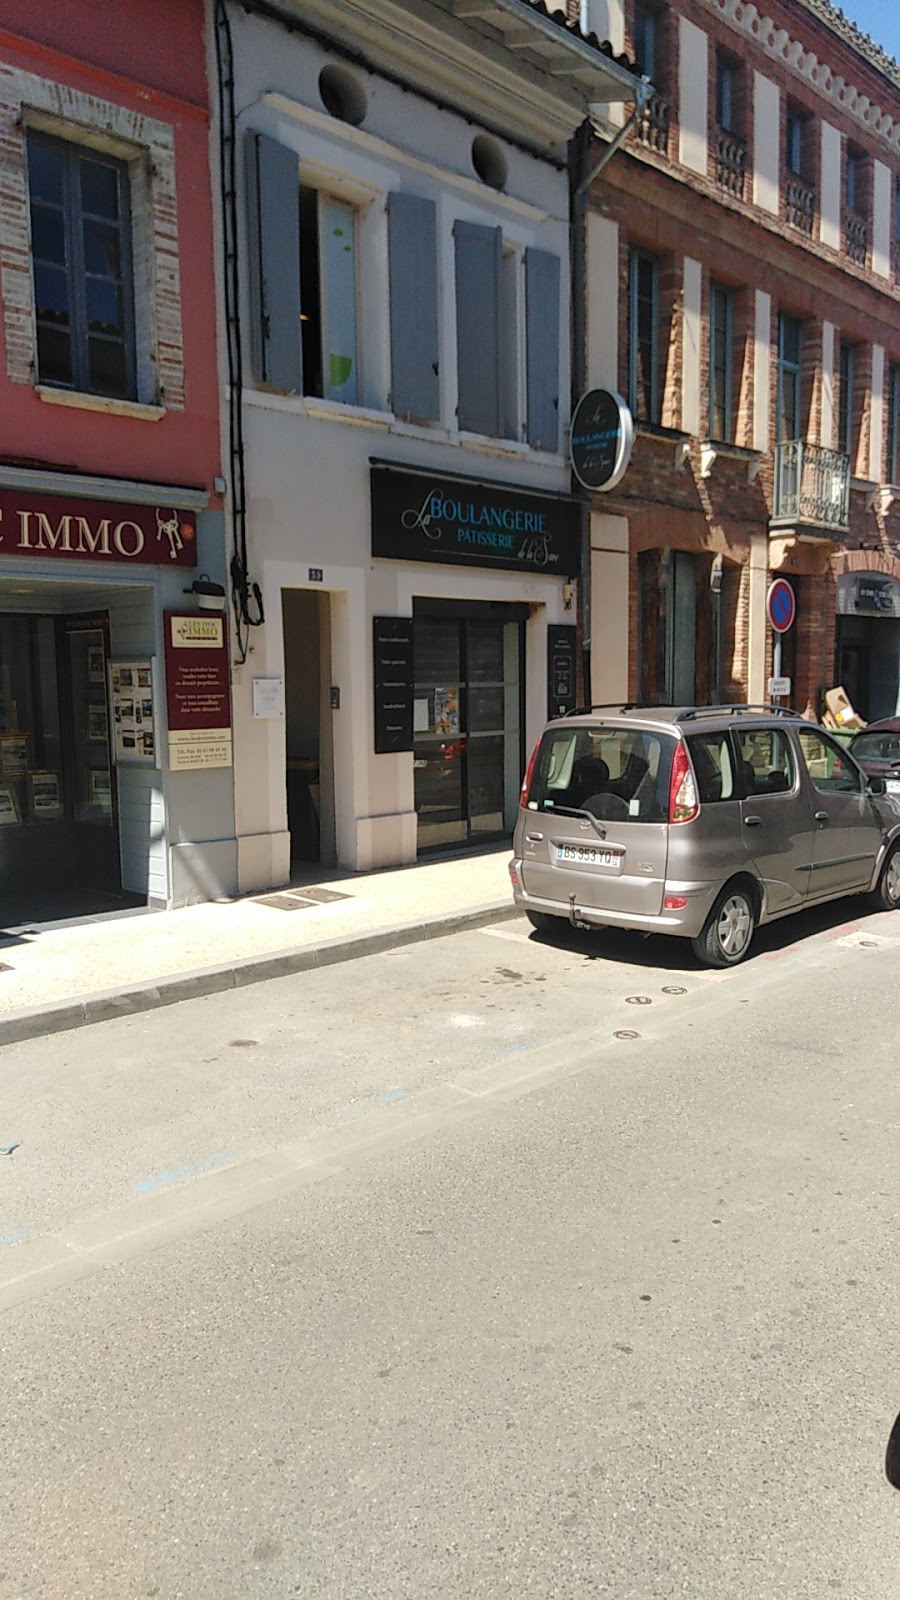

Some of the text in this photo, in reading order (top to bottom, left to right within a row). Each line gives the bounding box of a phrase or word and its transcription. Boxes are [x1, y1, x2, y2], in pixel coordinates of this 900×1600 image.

[430, 497, 547, 534] BOULANGERIE
[16, 510, 146, 557] IMMO
[188, 627, 218, 636] IMMO
[563, 845, 577, 859] BS
[578, 847, 597, 862] 953
[598, 850, 612, 864] YQ
